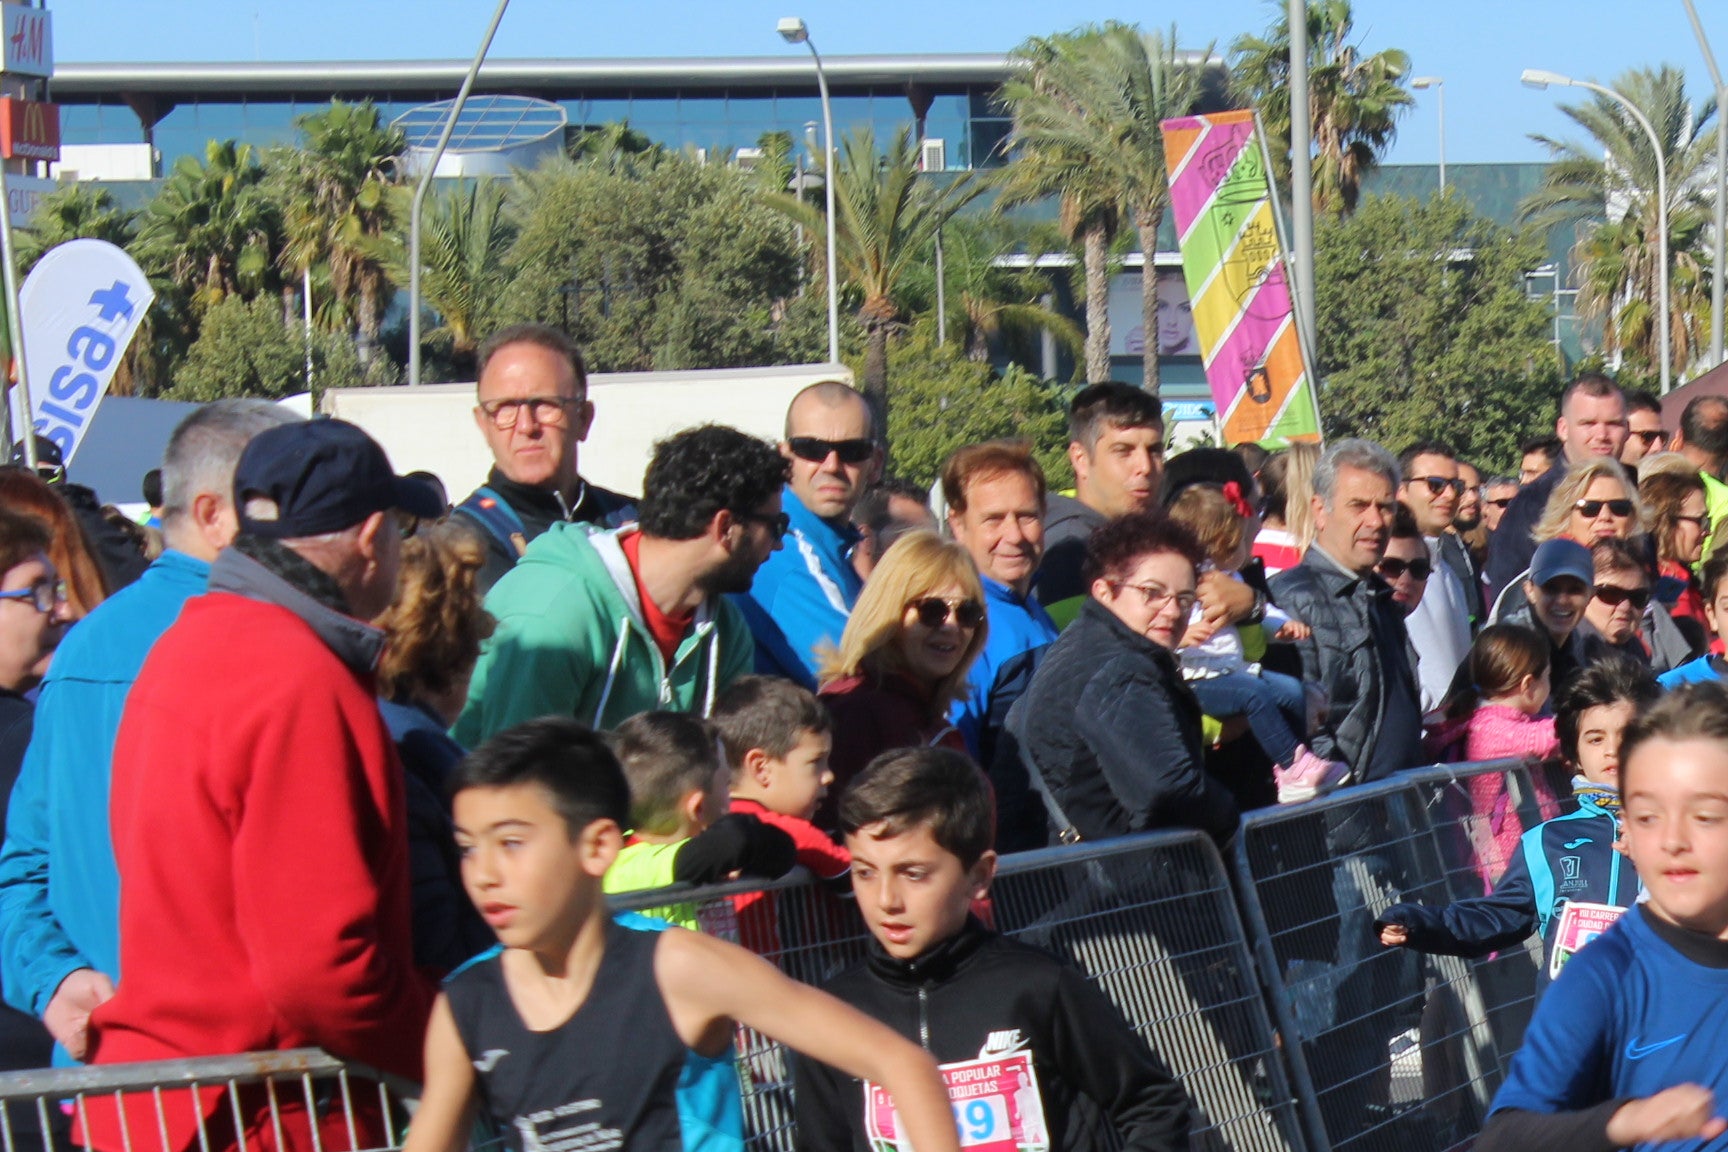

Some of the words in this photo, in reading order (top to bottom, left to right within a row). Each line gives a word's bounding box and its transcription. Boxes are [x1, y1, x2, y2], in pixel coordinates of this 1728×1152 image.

[1577, 919, 1603, 930] CIUDAD
[986, 1028, 1021, 1052] NIKE
[951, 1064, 1002, 1084] POPULAR
[949, 1080, 999, 1099] OQUETAS
